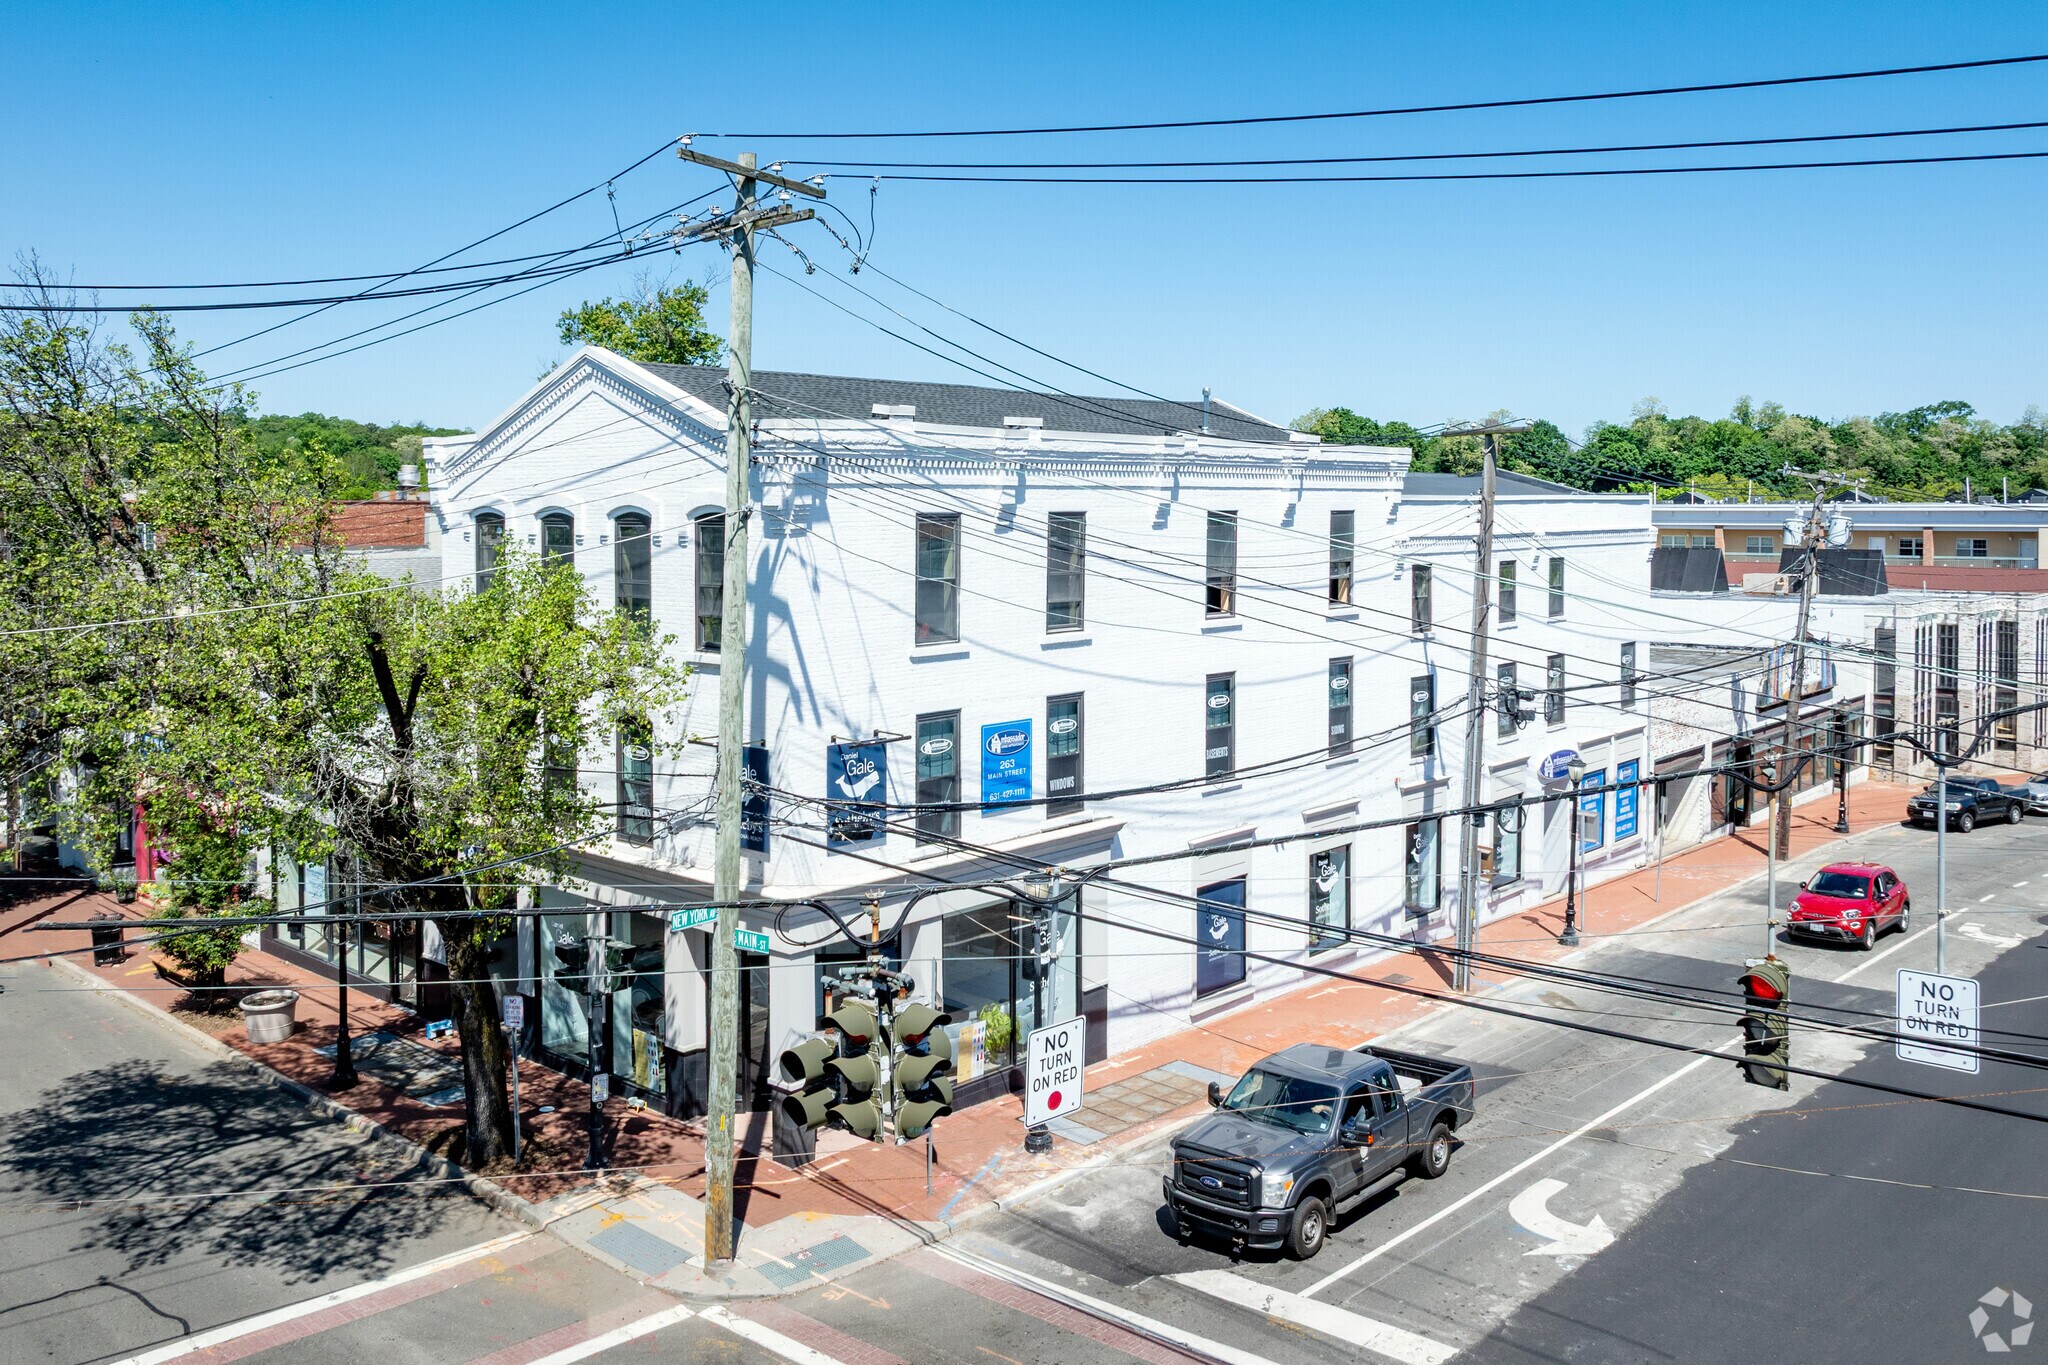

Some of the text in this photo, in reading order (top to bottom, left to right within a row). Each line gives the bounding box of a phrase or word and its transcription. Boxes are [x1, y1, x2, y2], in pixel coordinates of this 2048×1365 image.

[840, 751, 859, 761] Daniel
[999, 759, 1015, 769] 263
[740, 764, 757, 782] ale
[846, 758, 875, 776] Gale
[987, 767, 1027, 780] MAIN STREET
[1049, 776, 1075, 792] WINDOWS
[989, 788, 1026, 801] 631-427-1111
[1321, 863, 1337, 876] Gale
[672, 912, 688, 929] NEW
[689, 908, 709, 924] YORK
[1213, 916, 1227, 927] Gale
[556, 929, 575, 944] Gale
[738, 931, 766, 950] MAIN ST
[1921, 980, 1954, 1001] NO
[1914, 999, 1959, 1020] TURN
[1906, 1015, 1969, 1038] ON RED
[1044, 1030, 1069, 1053] NO
[1039, 1049, 1072, 1072] TURN
[1033, 1066, 1078, 1093] ON RED
[1203, 1179, 1216, 1187] Ford
